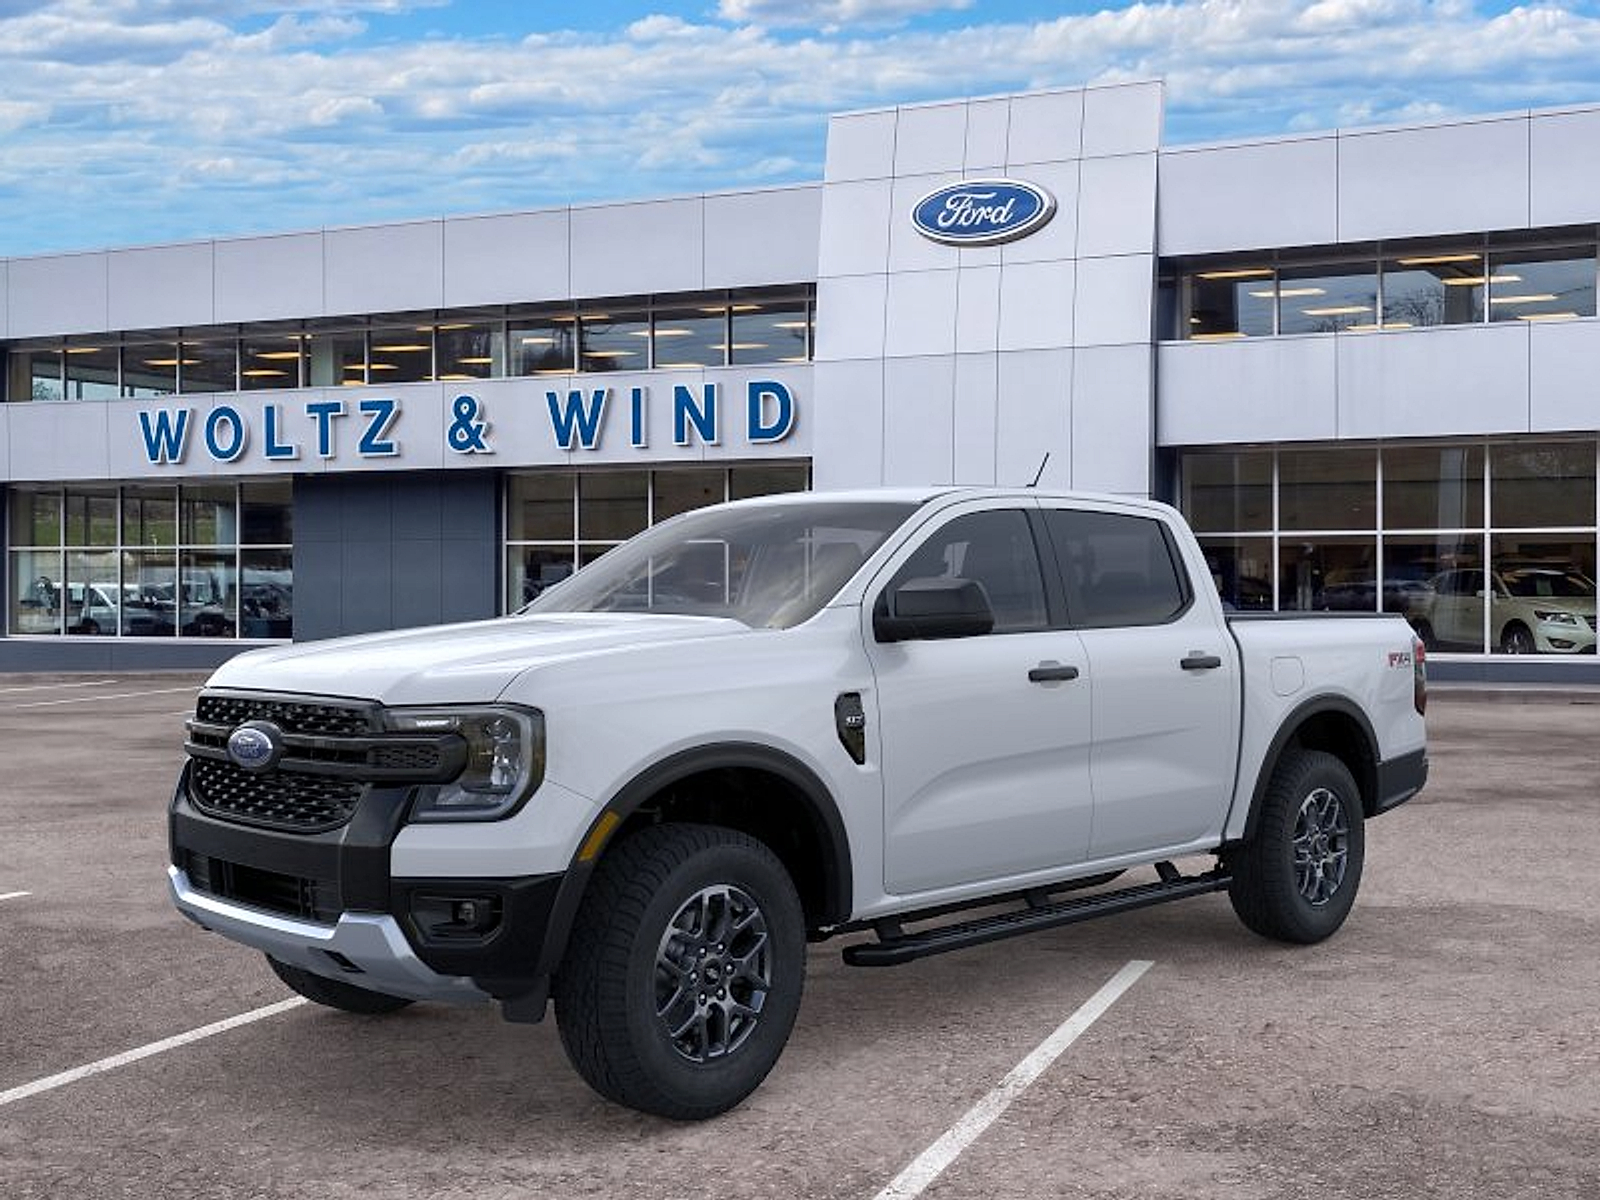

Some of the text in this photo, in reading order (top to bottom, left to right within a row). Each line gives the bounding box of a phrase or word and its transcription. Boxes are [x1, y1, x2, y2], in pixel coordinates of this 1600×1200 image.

[937, 192, 1015, 227] Ford
[139, 379, 795, 463] WOLTZ & WIND
